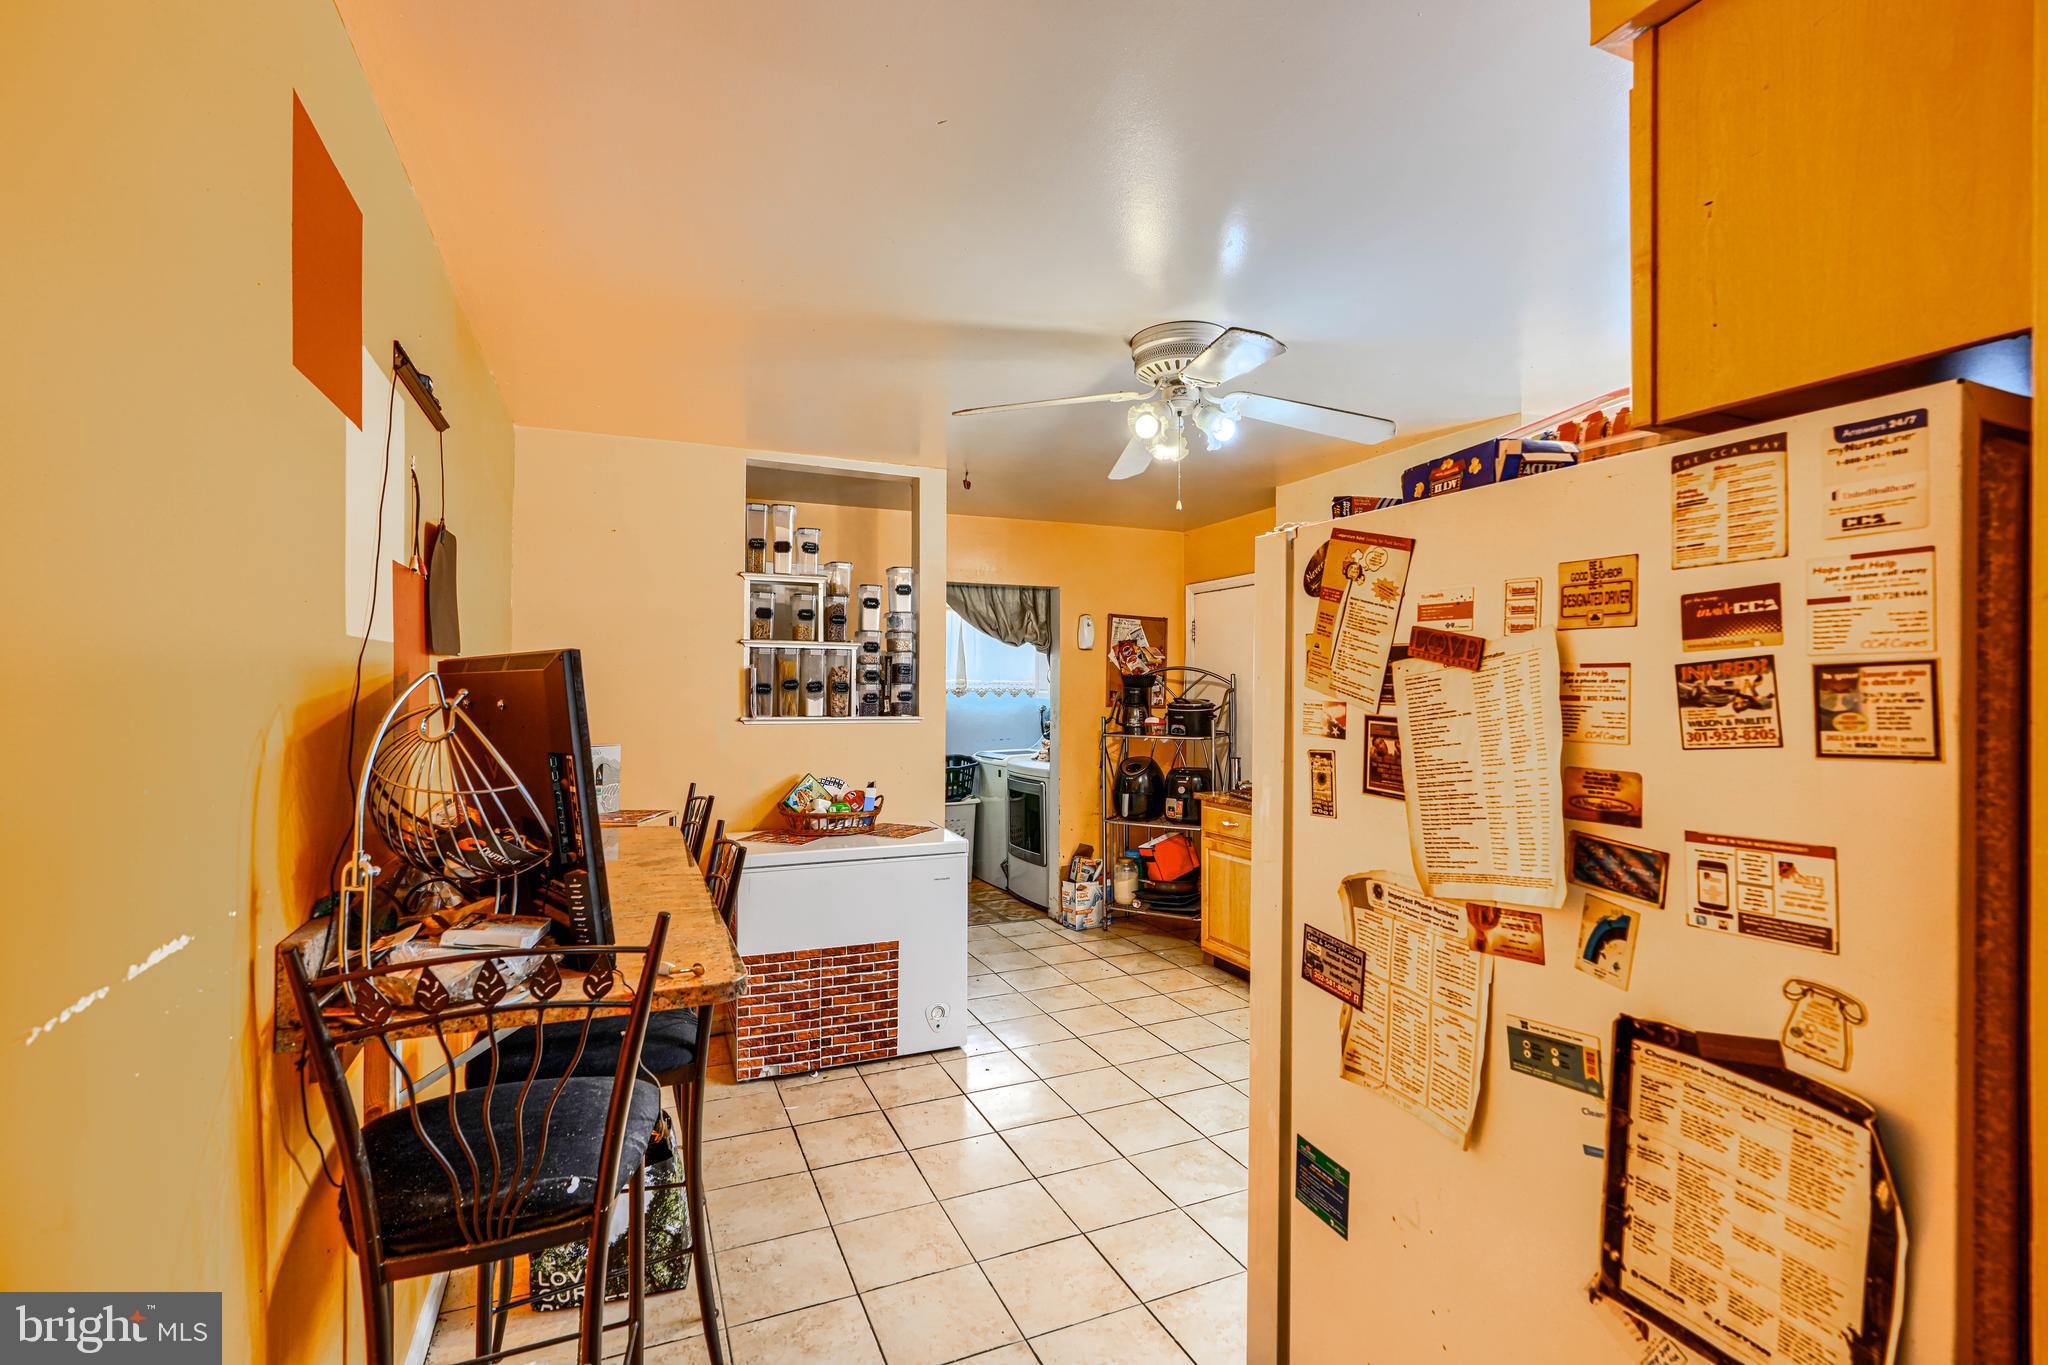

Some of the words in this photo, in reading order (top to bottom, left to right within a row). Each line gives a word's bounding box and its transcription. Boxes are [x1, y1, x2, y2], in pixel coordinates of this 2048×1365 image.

[1710, 447, 1738, 459] CCA
[1749, 441, 1779, 451] WAY
[1570, 571, 1588, 582] GOOD
[1589, 567, 1622, 579] NEIGHBOR
[1563, 592, 1602, 608] DESIGNATED
[1604, 589, 1631, 605] DRIVER
[1681, 658, 1770, 681] INJURED?
[1687, 718, 1723, 727] WILSON
[1725, 718, 1732, 726] &
[1735, 717, 1772, 726] PARLETT
[1686, 729, 1776, 742] 301-952-8205
[1387, 890, 1413, 905] Important
[1414, 900, 1432, 911] Phone
[1645, 1048, 1678, 1064] Choose
[1680, 1061, 1699, 1071] your
[538, 1270, 586, 1288] LOV
